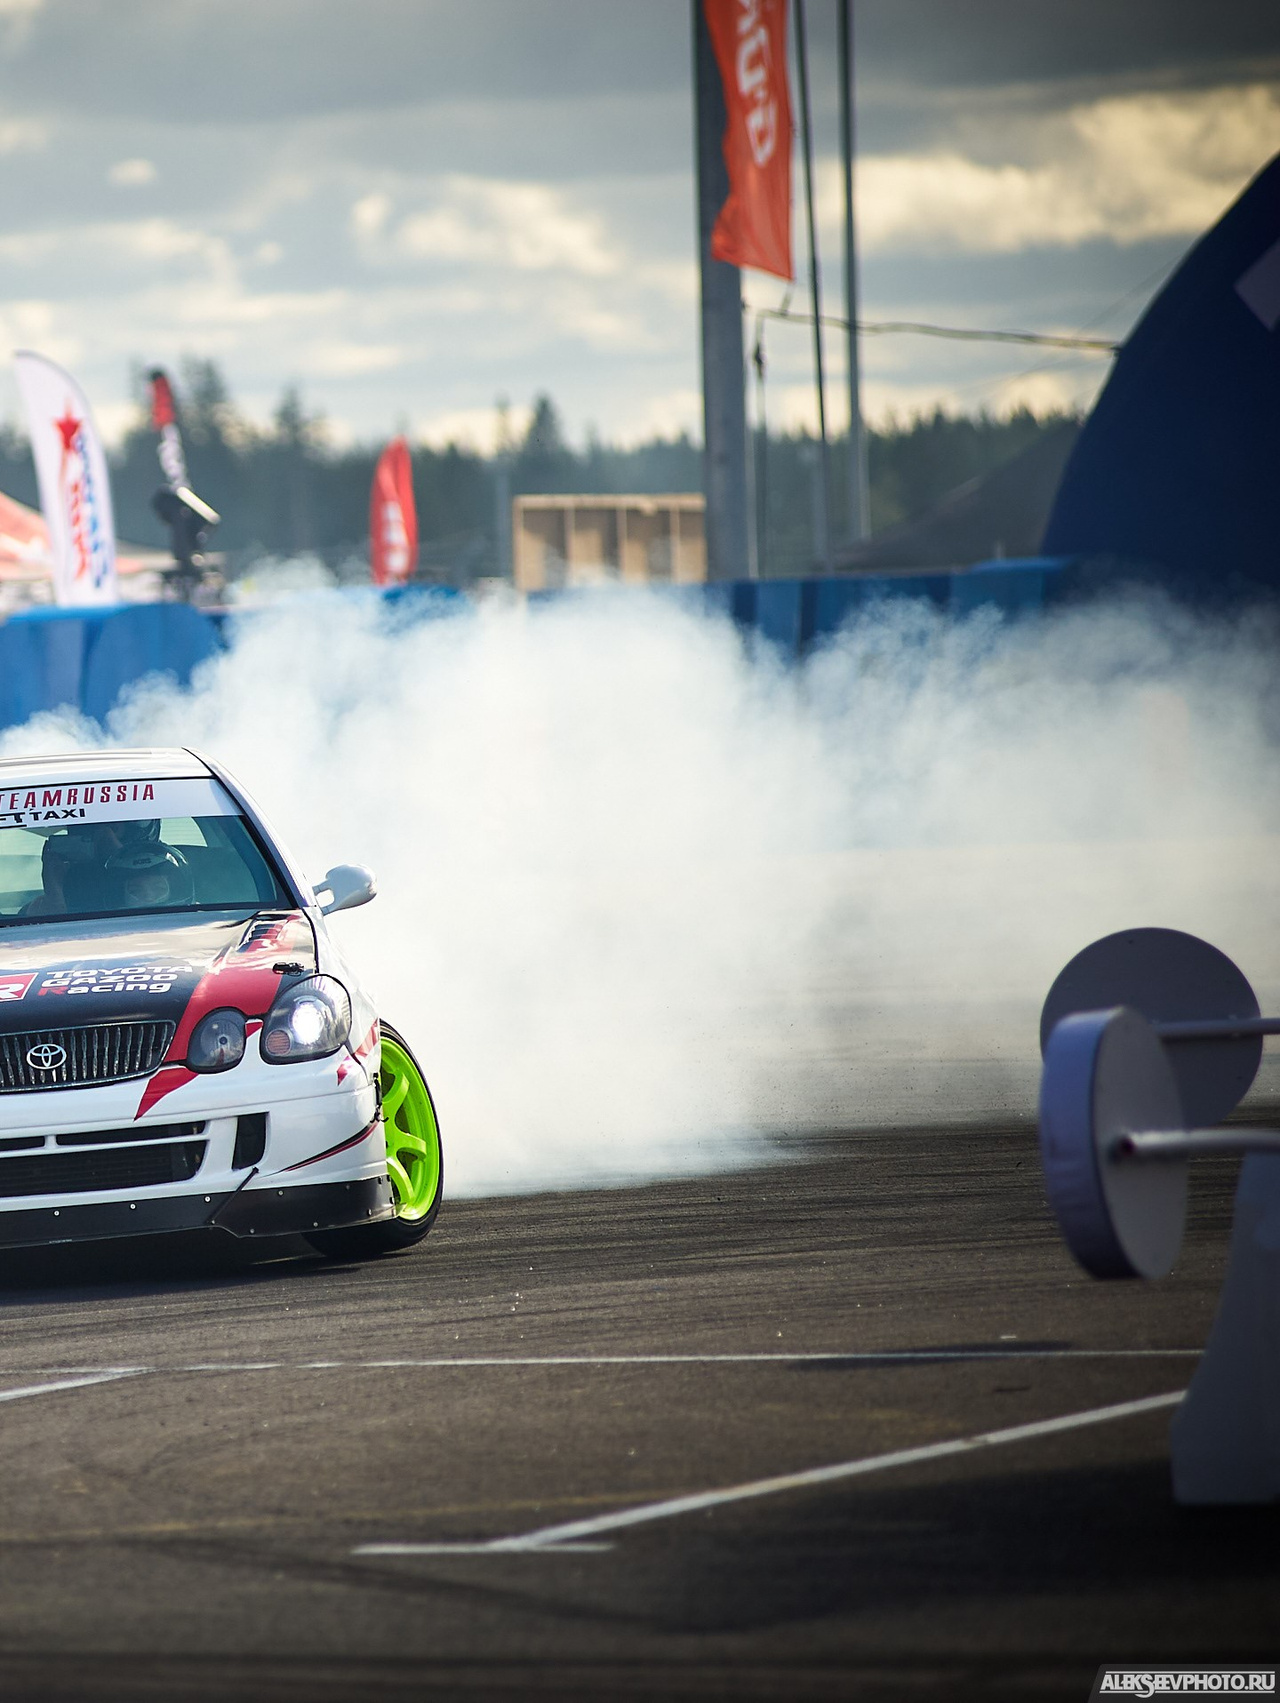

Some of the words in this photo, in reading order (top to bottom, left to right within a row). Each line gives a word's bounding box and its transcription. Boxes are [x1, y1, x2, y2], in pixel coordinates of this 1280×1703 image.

[29, 808, 86, 821] TAXI
[46, 966, 193, 979] TOYOTA
[41, 973, 178, 987] GAZOO
[38, 981, 172, 995] Racing
